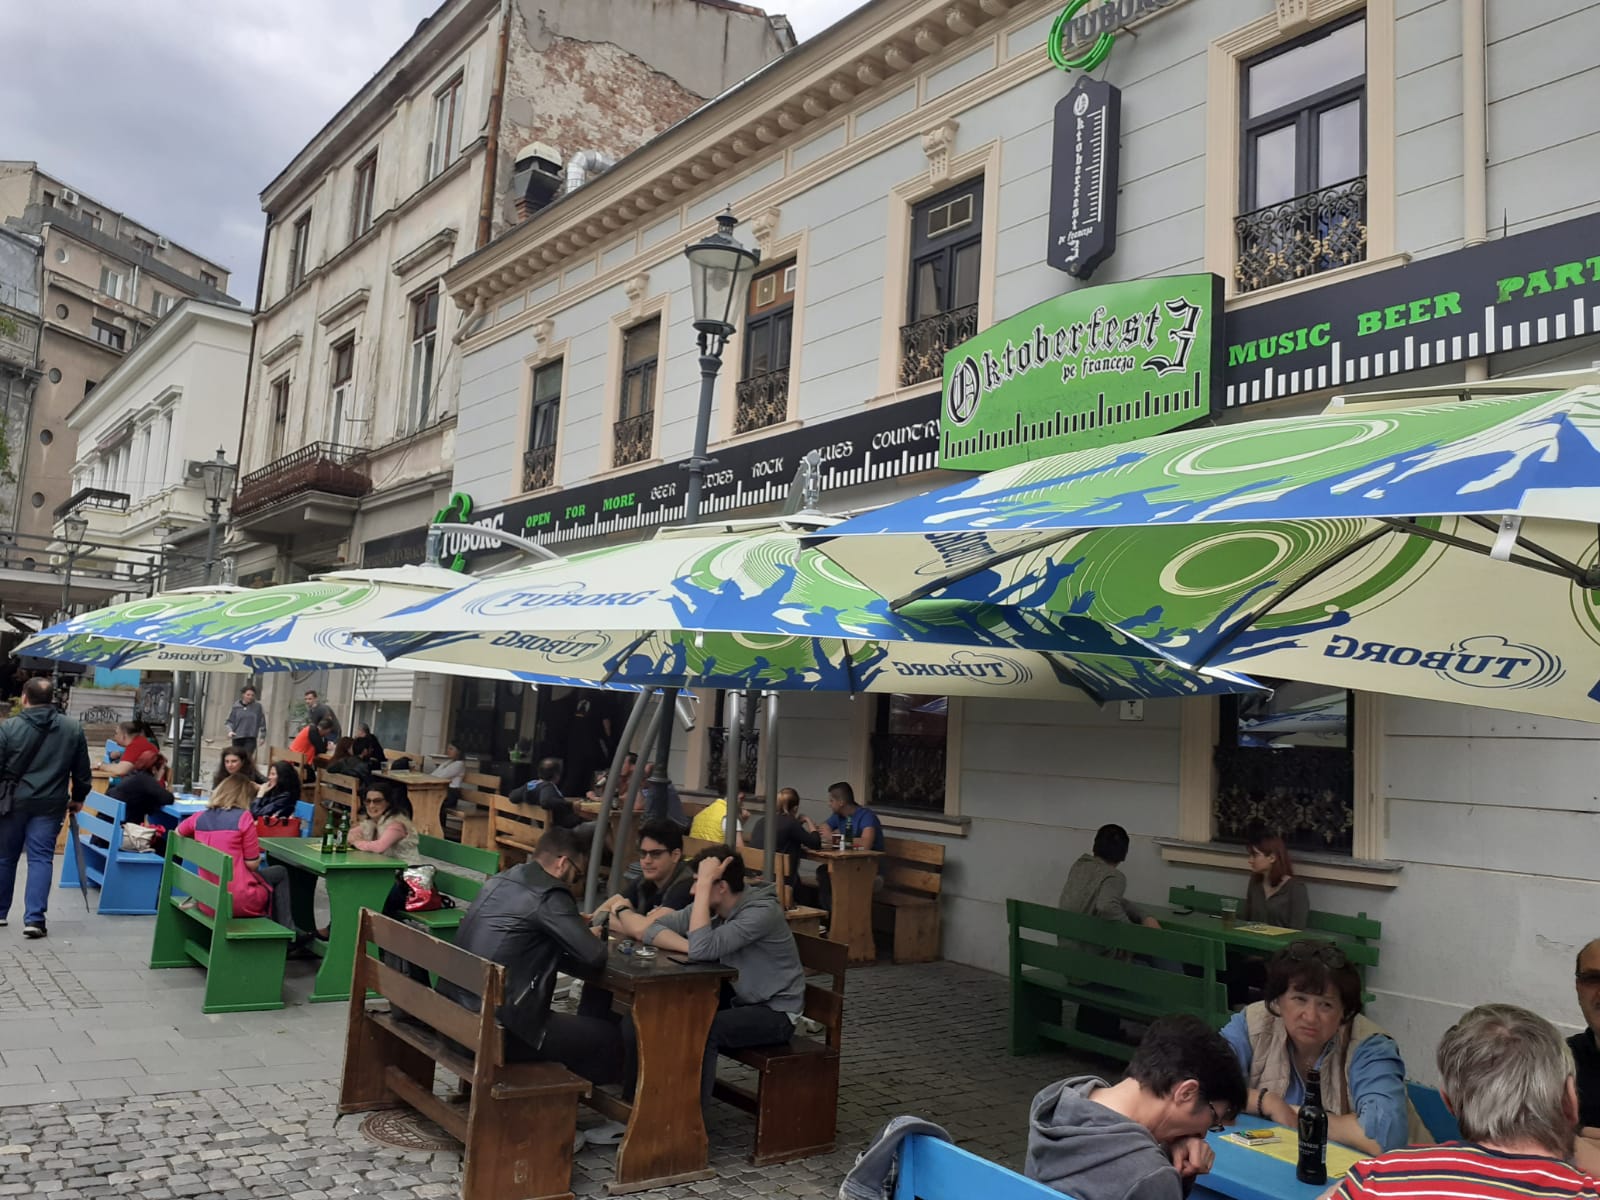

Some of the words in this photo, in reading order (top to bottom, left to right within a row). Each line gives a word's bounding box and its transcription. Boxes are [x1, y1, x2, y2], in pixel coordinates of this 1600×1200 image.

[1228, 322, 1331, 367] MUSIC
[1357, 291, 1462, 337] BEER
[946, 301, 1161, 426] Oktoberfest
[1062, 363, 1076, 383] pe
[525, 511, 551, 528] OPEN
[565, 503, 586, 519] FOR
[602, 492, 635, 512] MORE
[650, 481, 677, 500] BEER
[751, 457, 784, 478] ROCK
[815, 441, 853, 462] LUES
[441, 513, 504, 559] TUBORG
[494, 588, 661, 607] TUBORG
